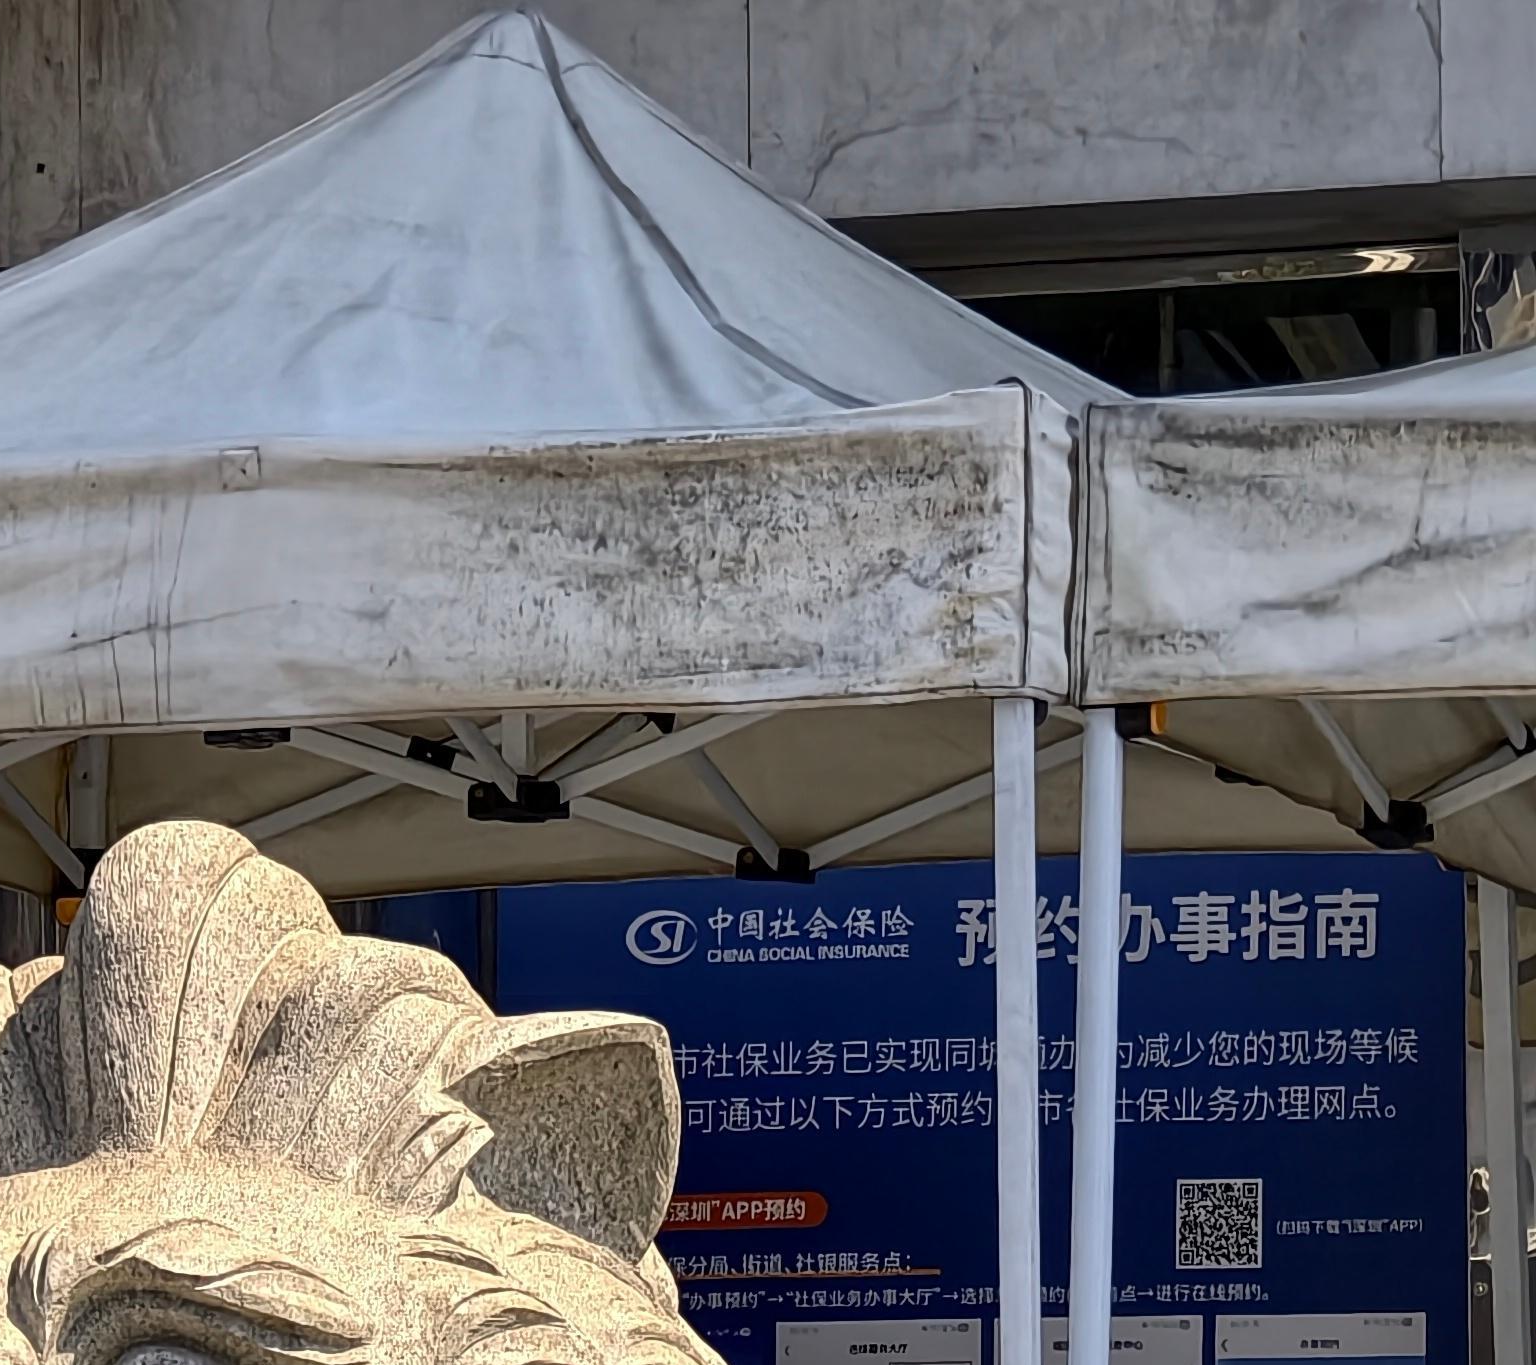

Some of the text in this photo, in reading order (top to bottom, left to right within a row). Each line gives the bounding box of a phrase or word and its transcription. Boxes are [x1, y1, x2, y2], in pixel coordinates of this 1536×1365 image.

[707, 904, 914, 946] 中国社会保险
[707, 944, 910, 963] CHINA SOCIAL INSURANCE
